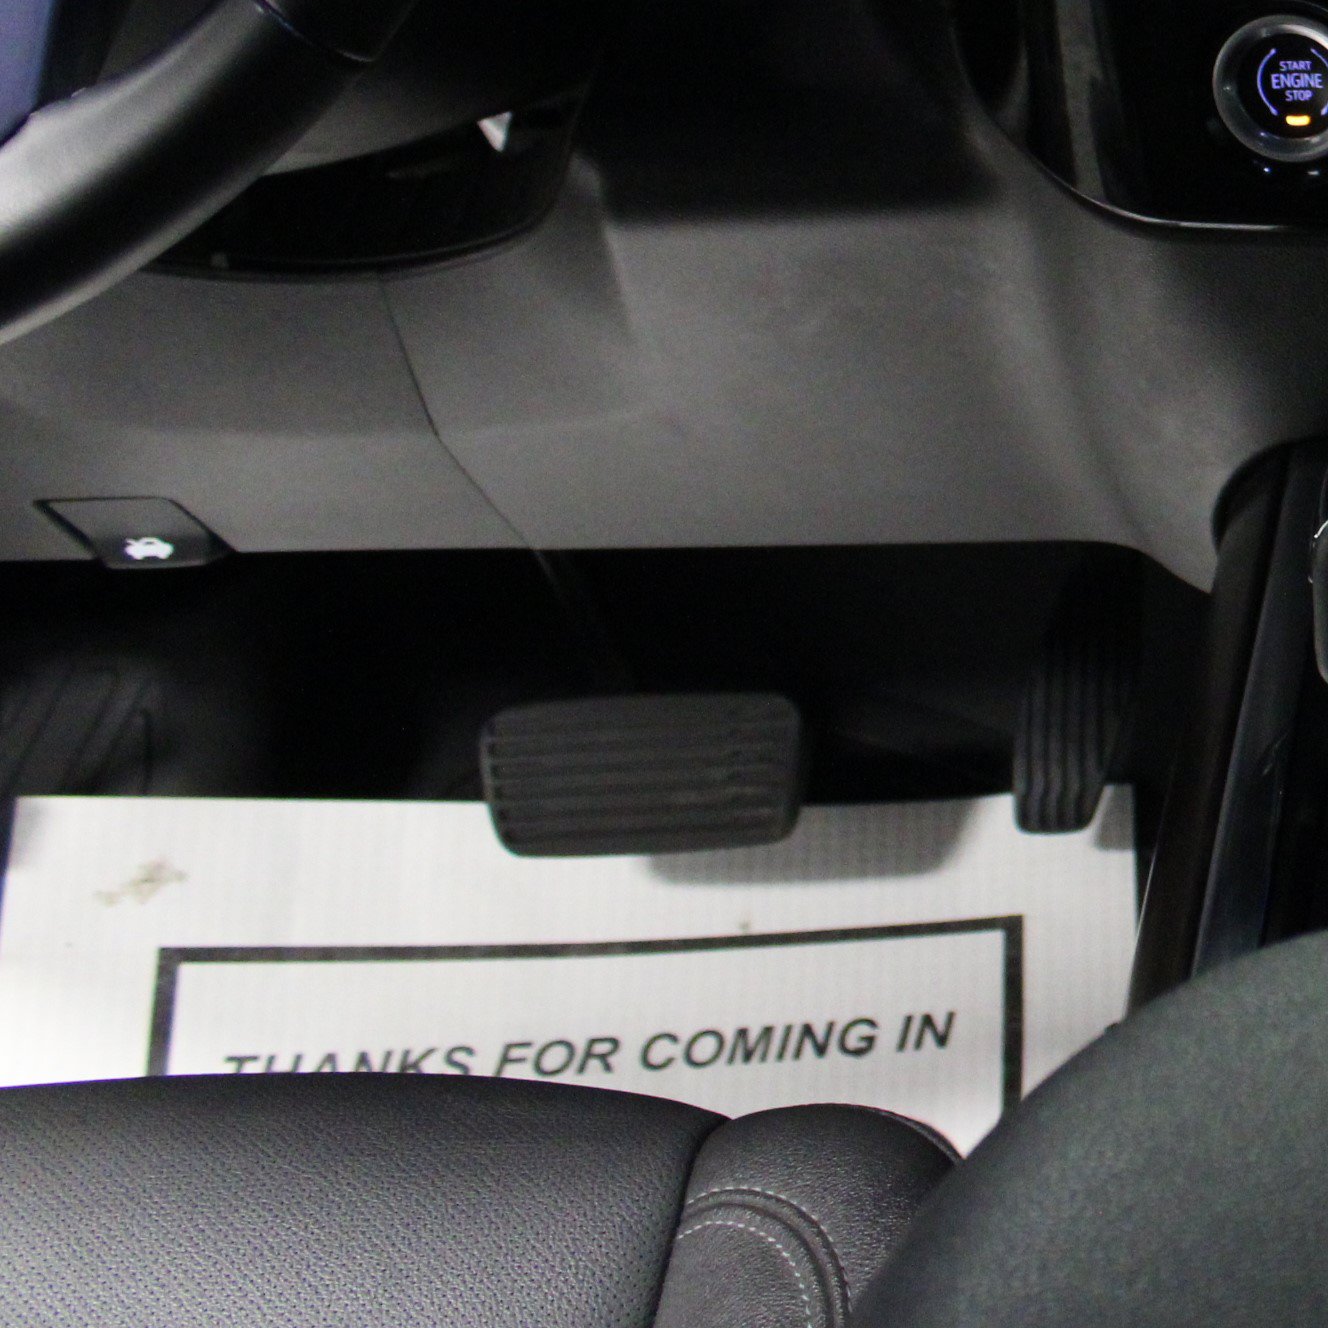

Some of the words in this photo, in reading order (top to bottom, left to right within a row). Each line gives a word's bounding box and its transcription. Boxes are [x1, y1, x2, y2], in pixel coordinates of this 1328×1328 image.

[1279, 60, 1312, 72] START
[1270, 72, 1324, 90] ENGINE
[1285, 88, 1313, 102] STOP
[494, 1036, 621, 1078] FOR
[639, 1017, 878, 1073] COMING
[896, 1010, 957, 1053] IN
